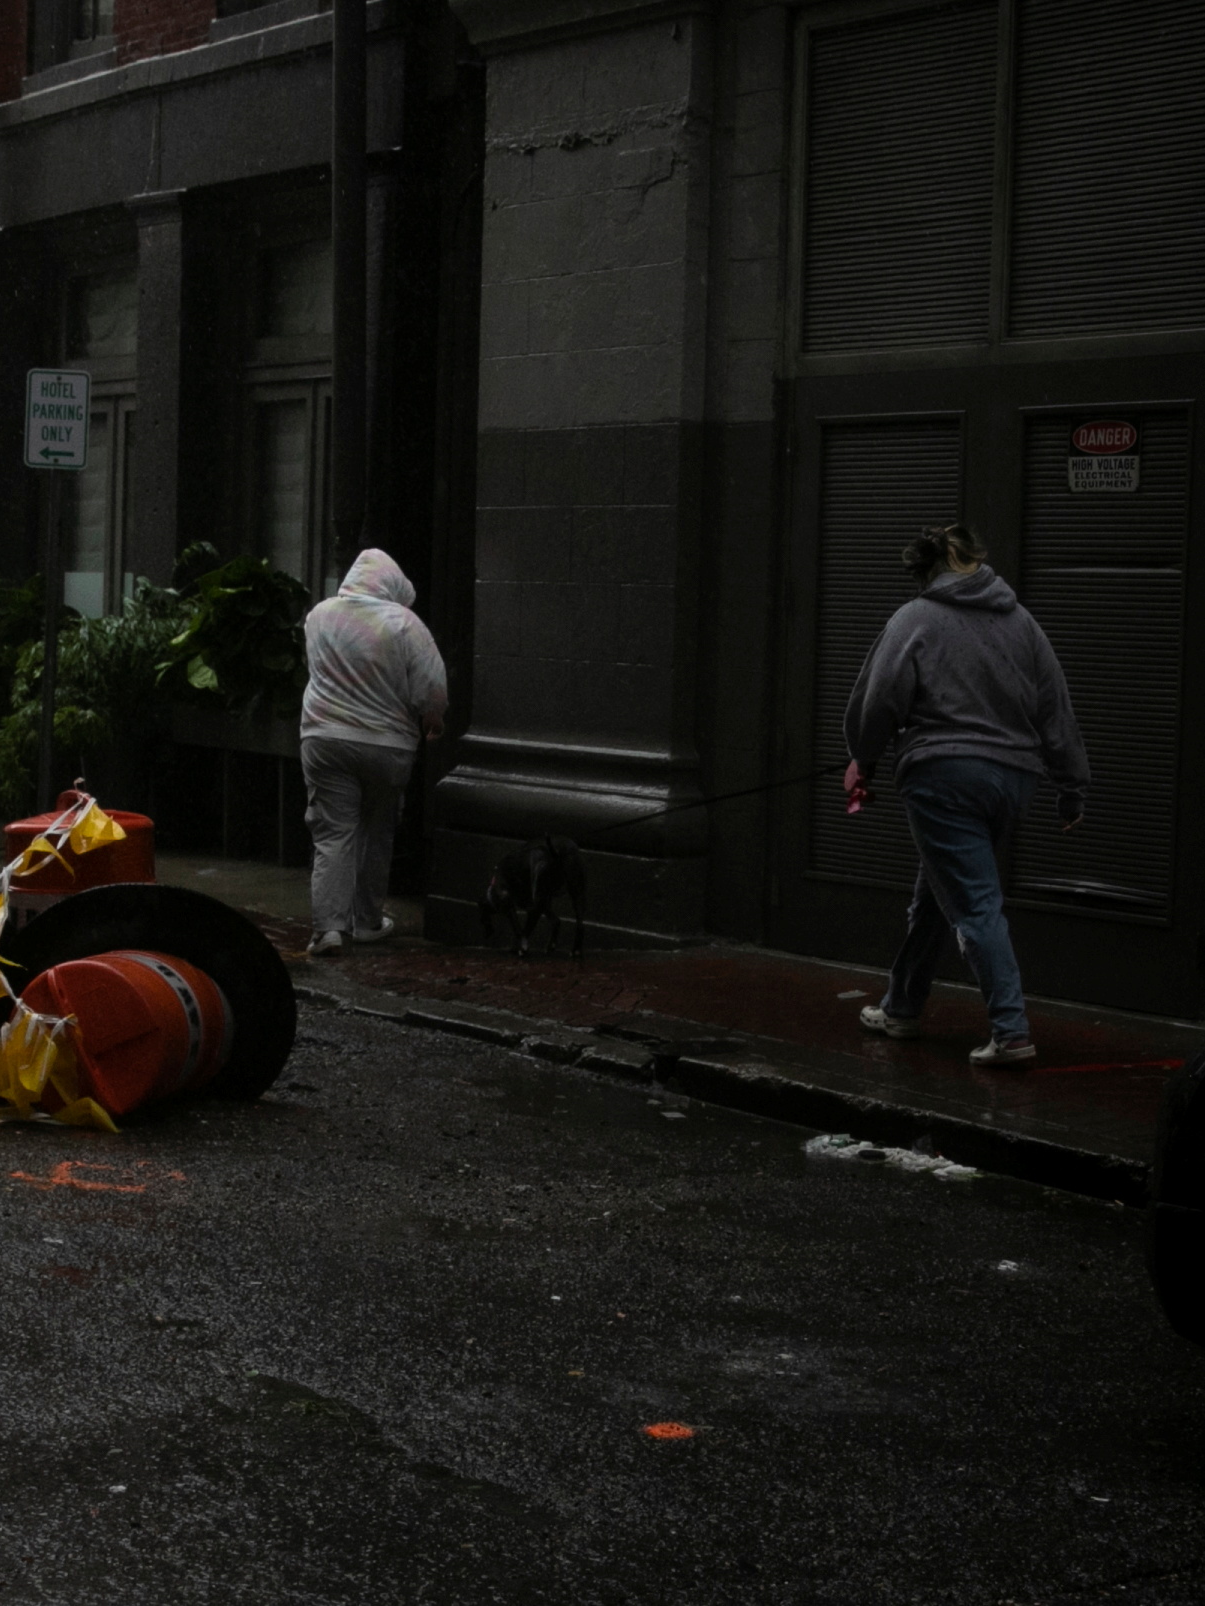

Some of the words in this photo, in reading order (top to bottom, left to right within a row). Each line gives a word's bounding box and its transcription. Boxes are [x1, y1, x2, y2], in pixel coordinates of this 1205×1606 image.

[41, 382, 76, 398] HOTEL
[32, 403, 83, 420] PARKING
[41, 426, 73, 442] ONLY
[1079, 427, 1131, 446] DANGER
[1072, 459, 1093, 470] HIGH
[1097, 458, 1135, 470] VOLTAGE
